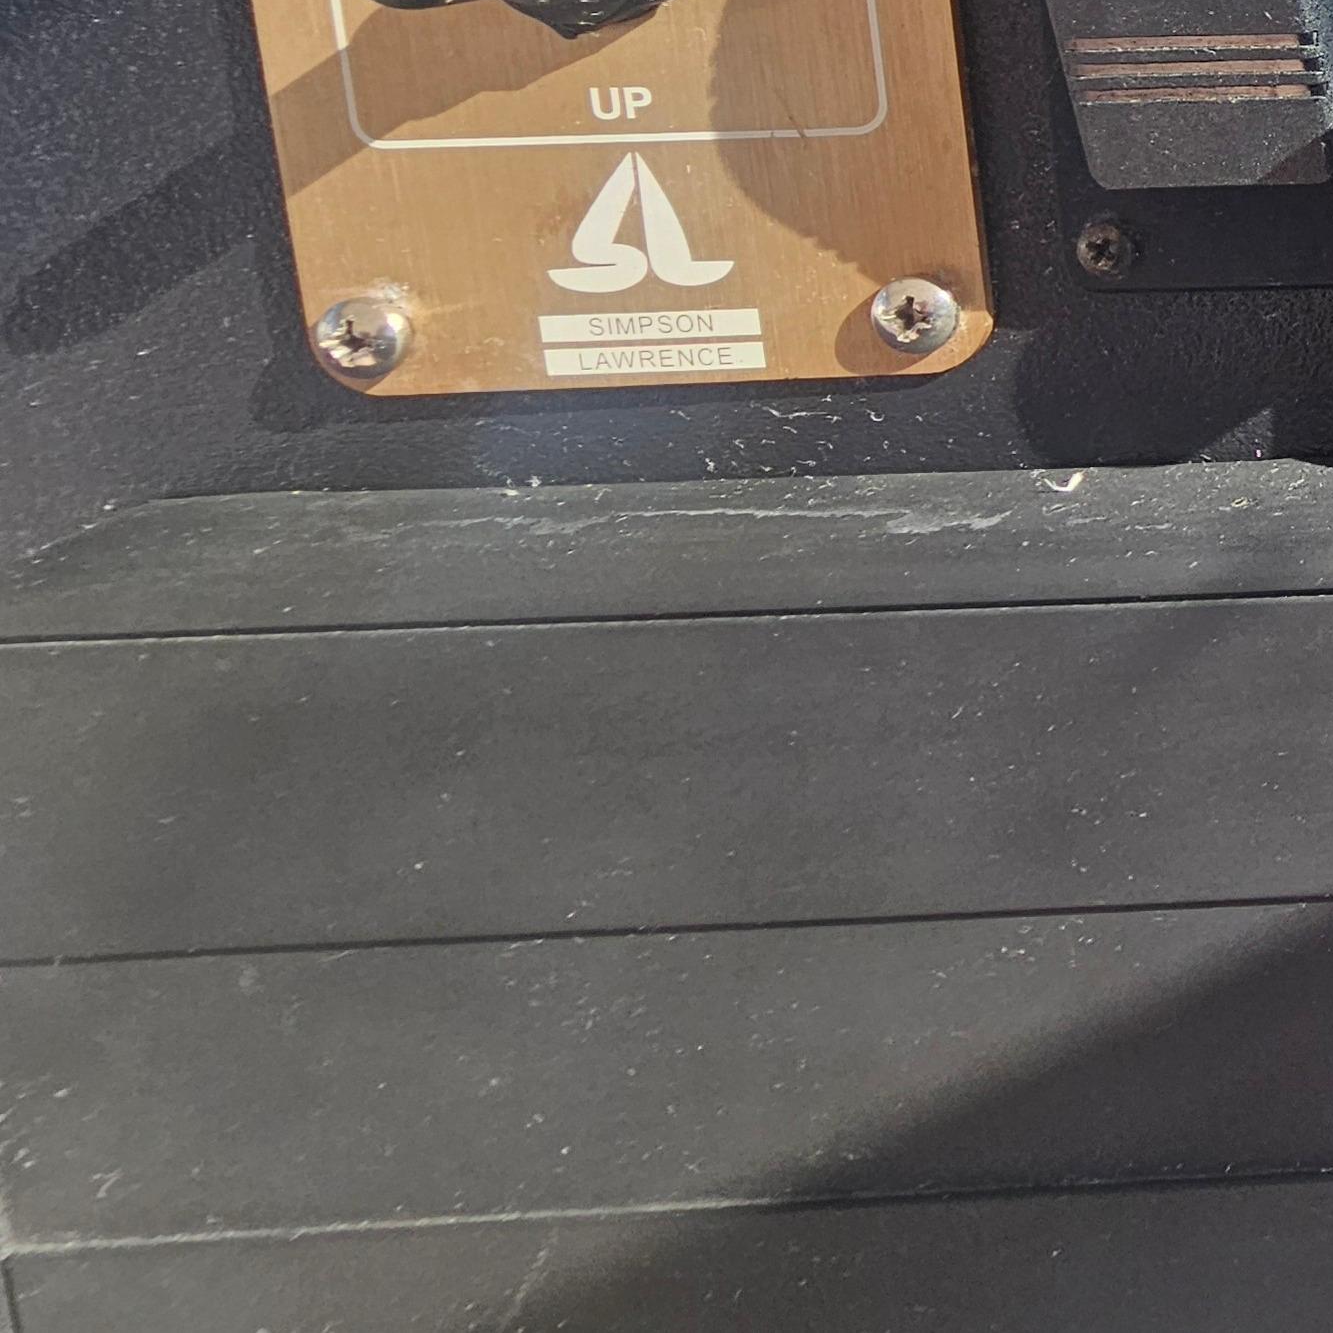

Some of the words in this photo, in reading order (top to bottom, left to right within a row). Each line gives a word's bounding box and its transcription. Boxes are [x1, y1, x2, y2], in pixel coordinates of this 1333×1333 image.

[590, 86, 652, 120] UP
[588, 314, 714, 336] SIMPSON
[579, 346, 733, 370] LAWRENCE
